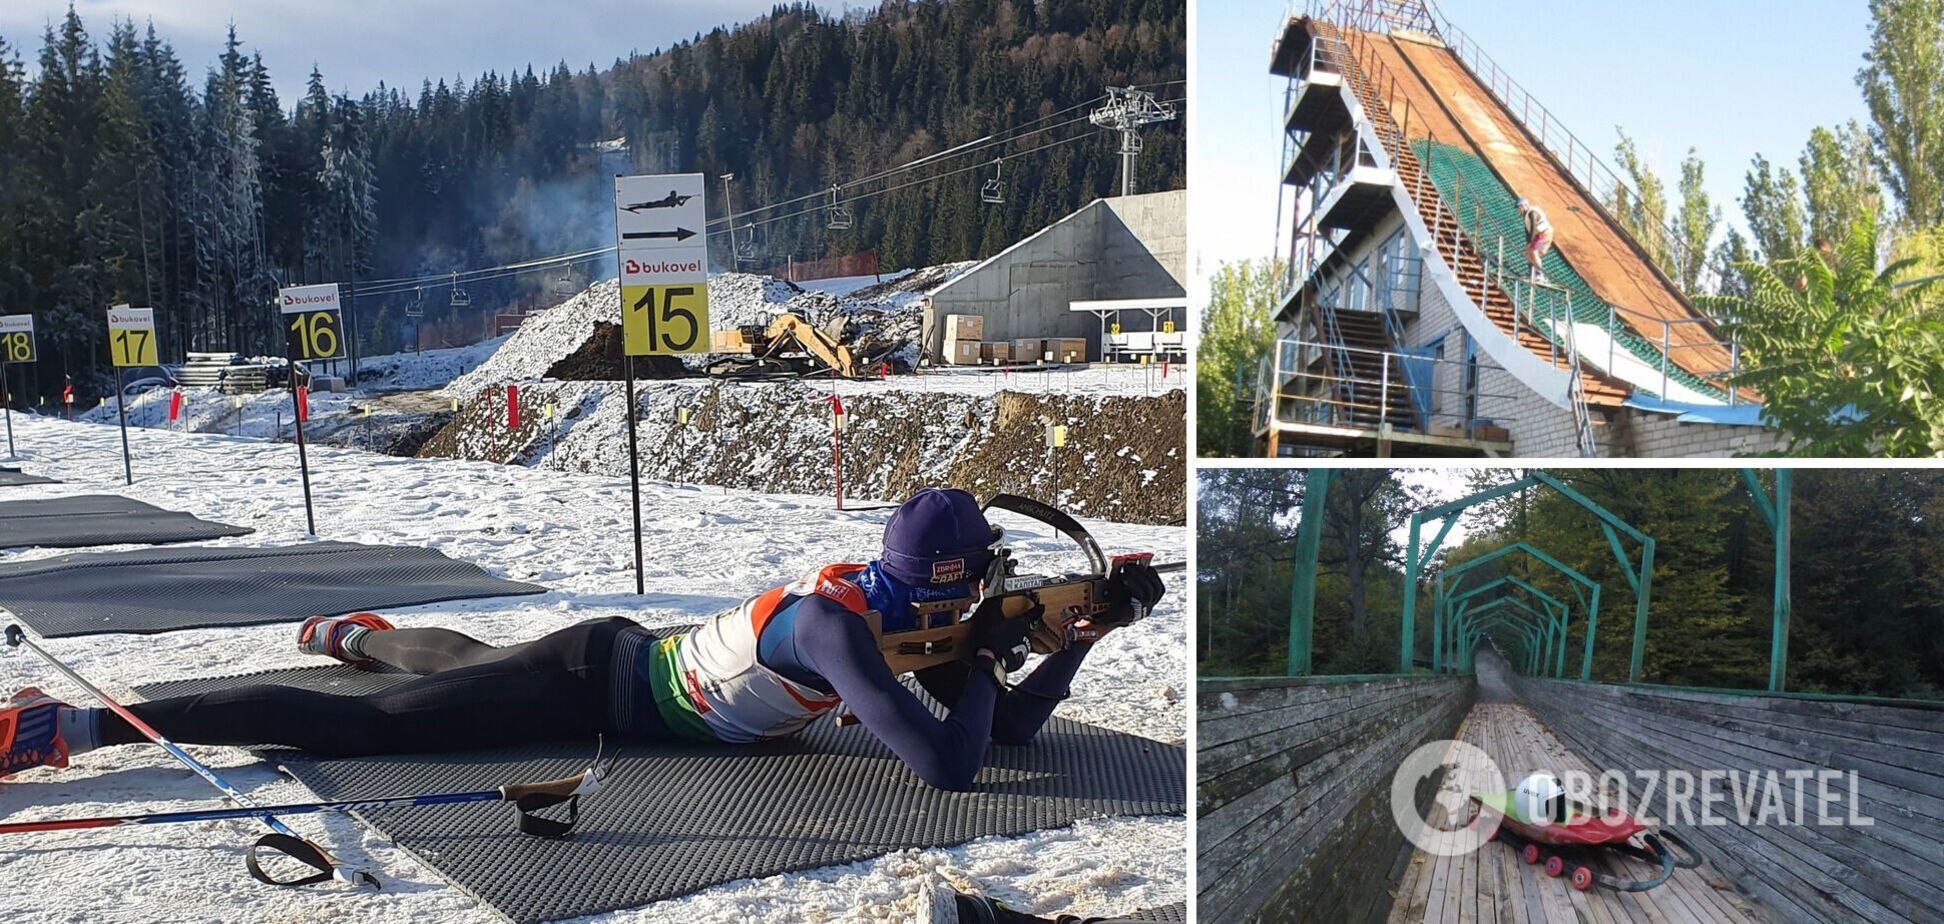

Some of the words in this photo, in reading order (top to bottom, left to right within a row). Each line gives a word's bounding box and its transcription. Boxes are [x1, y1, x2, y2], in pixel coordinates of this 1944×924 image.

[642, 260, 701, 274] bukovel
[295, 293, 335, 304] bukovel
[4, 321, 30, 329] bukovel
[120, 315, 150, 324] bukovel
[633, 287, 698, 352] 15
[291, 311, 337, 359] 16
[1, 332, 31, 361] 18
[116, 329, 149, 364] 17
[930, 571, 965, 584] CRAFT
